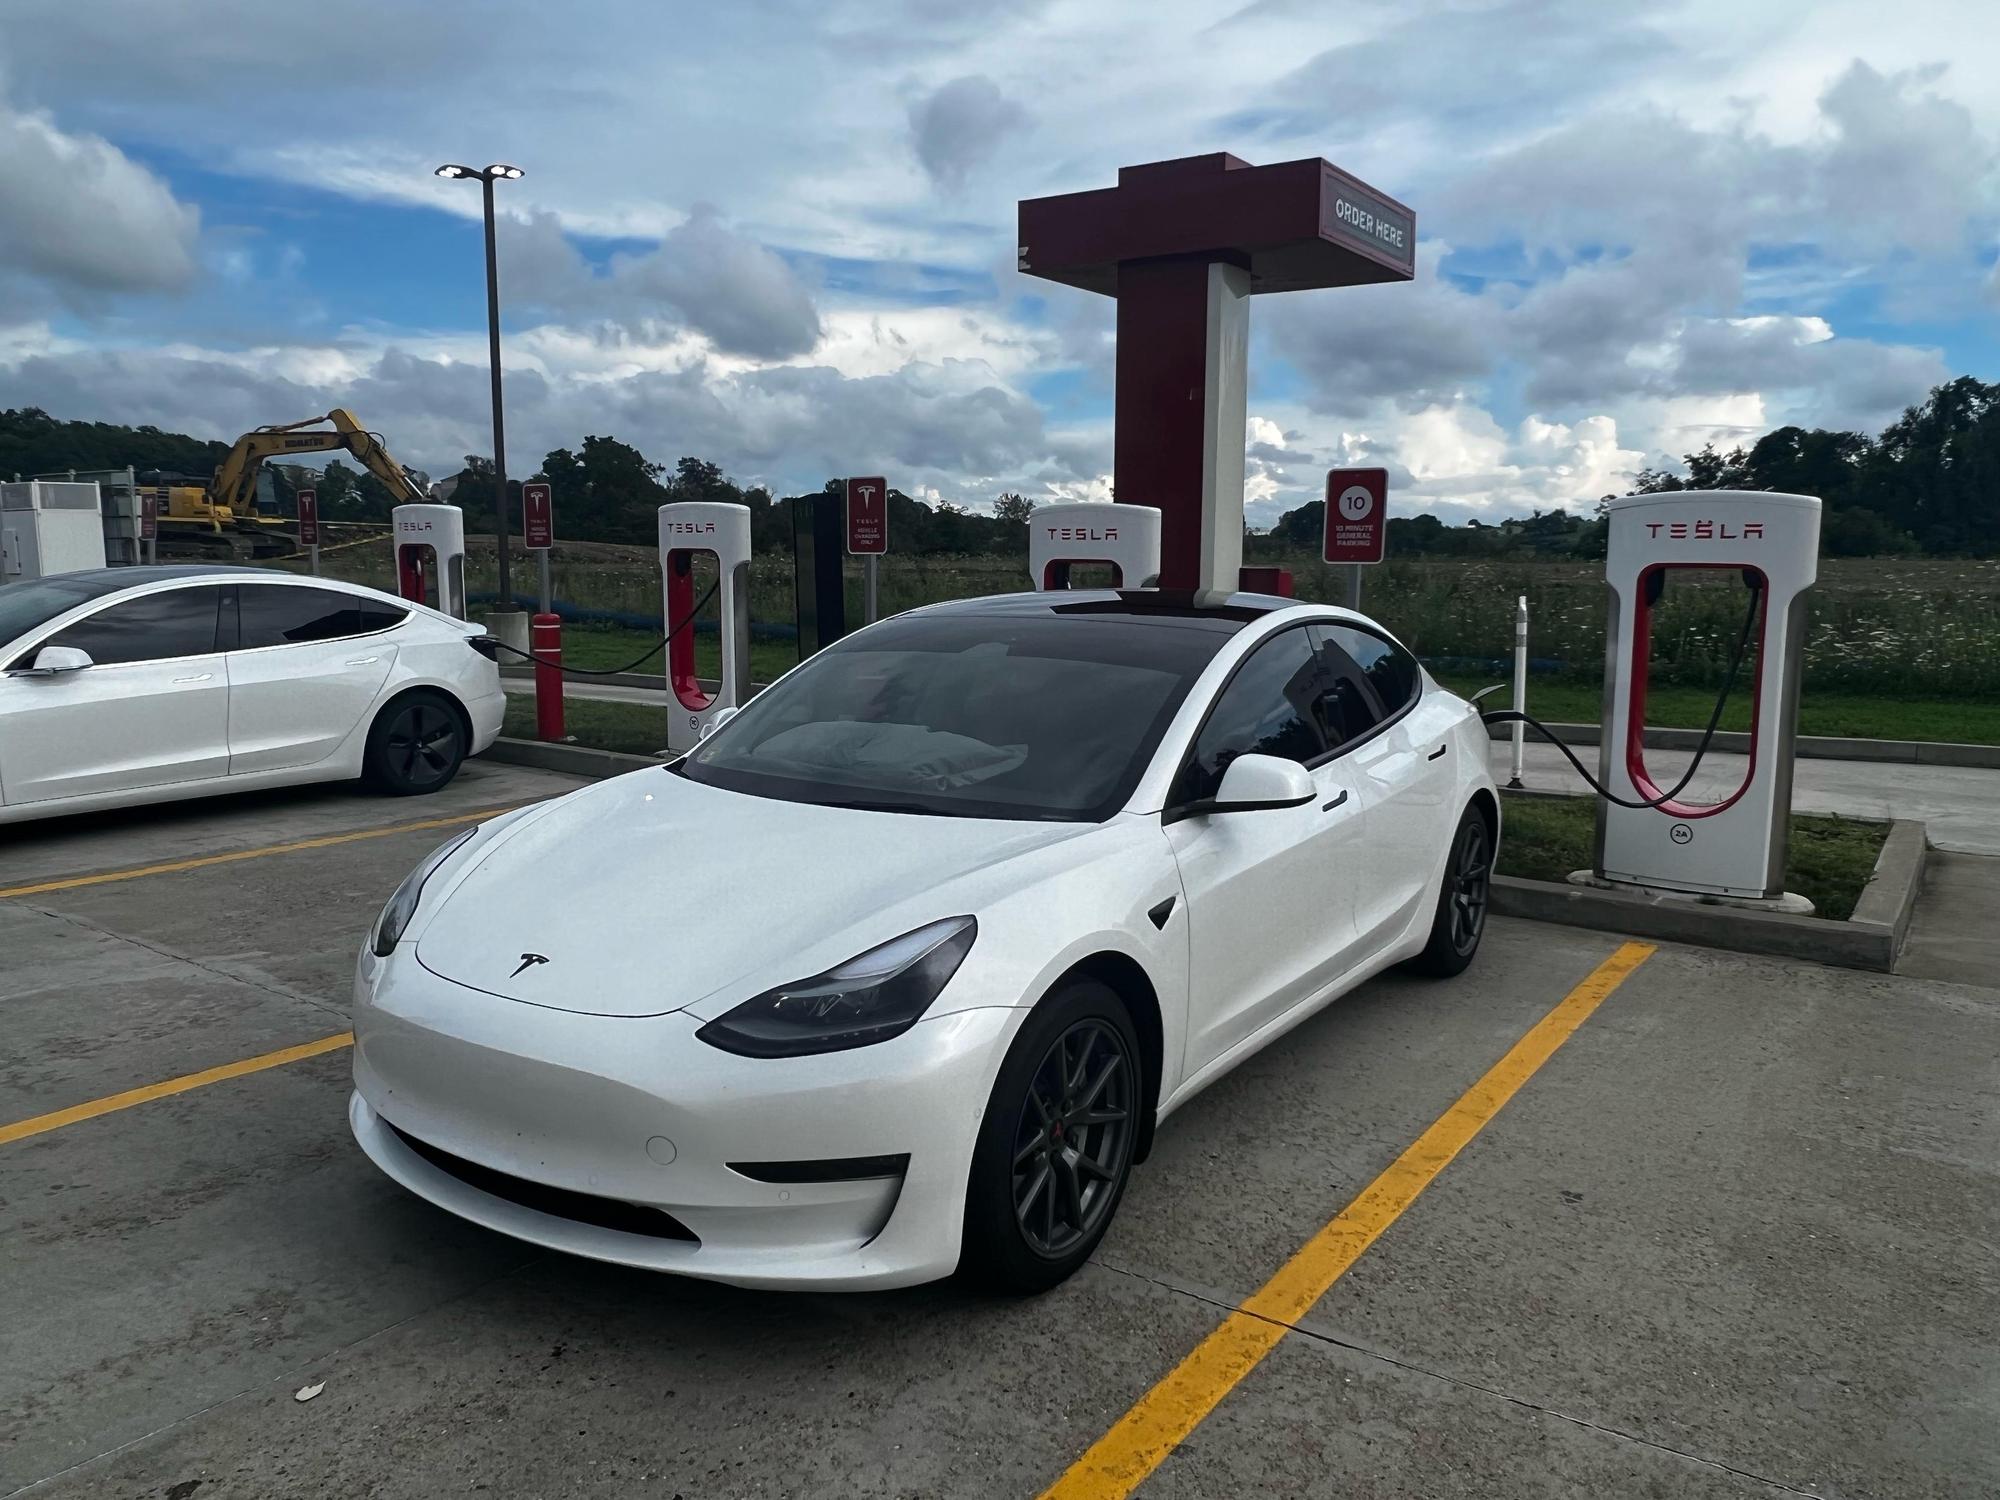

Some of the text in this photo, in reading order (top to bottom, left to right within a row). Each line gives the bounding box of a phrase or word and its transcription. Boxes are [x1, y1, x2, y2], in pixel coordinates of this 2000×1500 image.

[1336, 198, 1403, 248] ORDER HERE
[1347, 496, 1366, 511] 10
[398, 522, 432, 531] TESLA
[667, 523, 715, 533] TESLA
[1645, 522, 1764, 539] TESLA
[1048, 528, 1117, 540] TESLA
